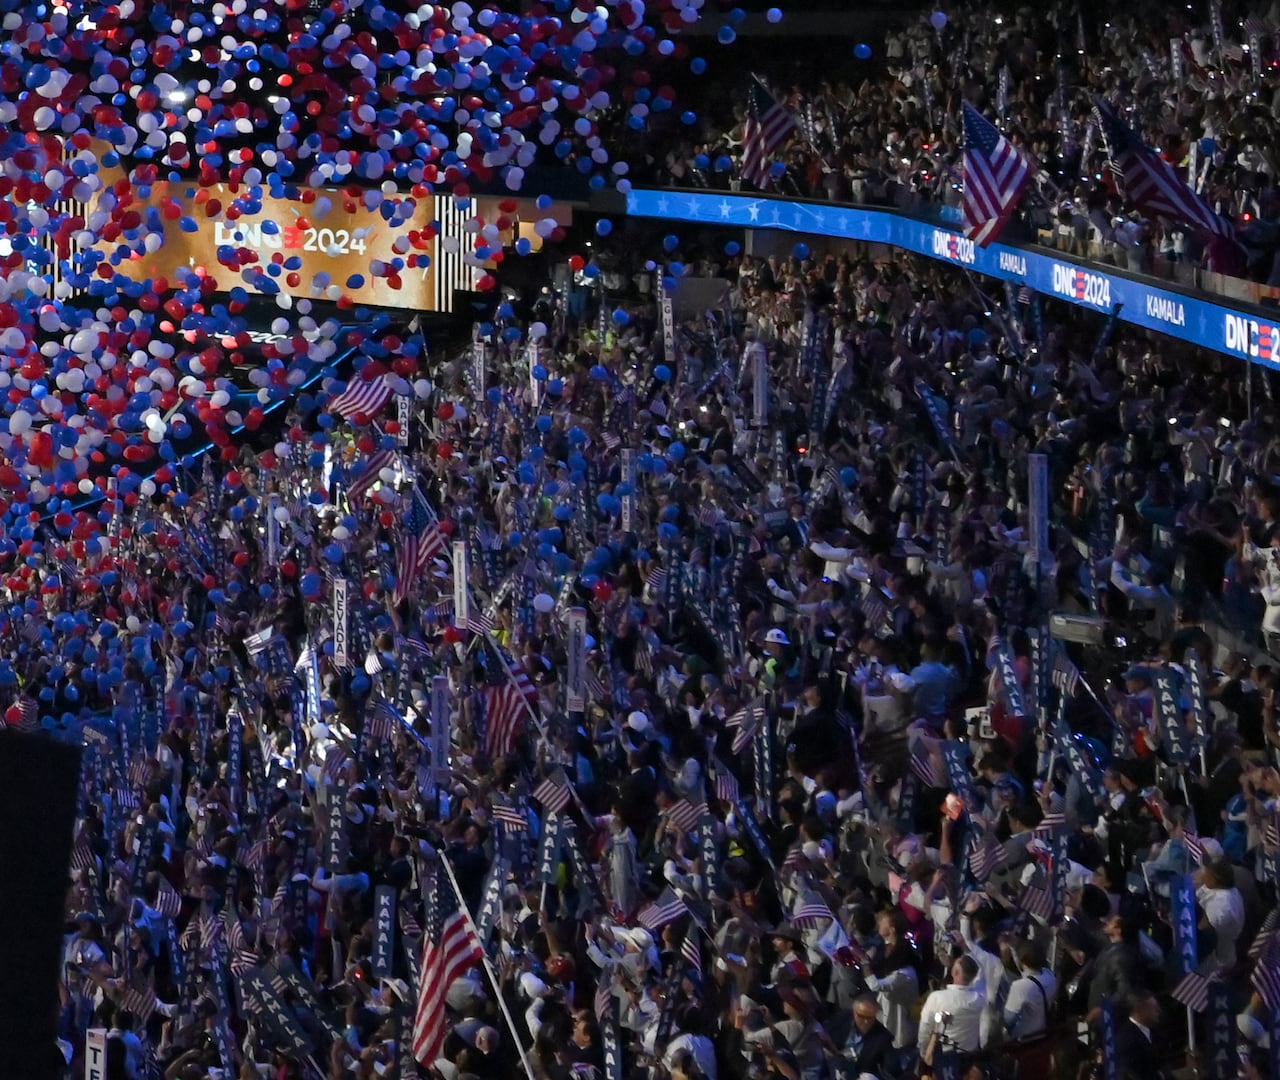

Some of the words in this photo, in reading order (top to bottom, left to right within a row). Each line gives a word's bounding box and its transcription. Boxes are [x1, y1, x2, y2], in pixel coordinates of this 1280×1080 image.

[303, 227, 367, 256] 2024
[934, 228, 956, 259] DNC
[955, 236, 975, 262] 2024
[1000, 251, 1027, 276] KAMALA
[1053, 263, 1077, 299] DNC
[1083, 271, 1111, 308] 2024
[1146, 293, 1184, 326] KAMALA
[335, 588, 345, 655] NEVADA
[1157, 677, 1185, 755] KAMALA
[231, 723, 239, 780] KAMALA
[330, 794, 341, 864] KAMALA
[377, 895, 390, 968] KAMALA
[251, 977, 305, 1047] KAMALA
